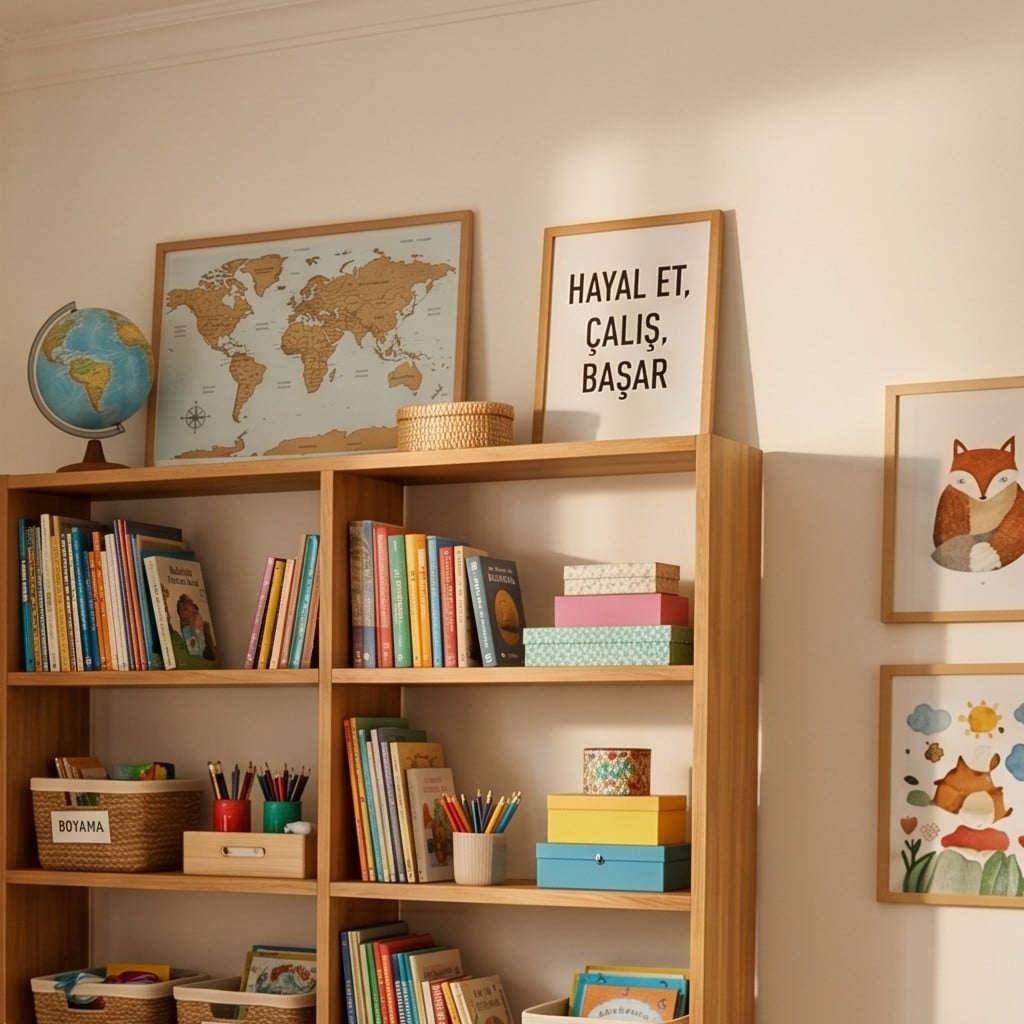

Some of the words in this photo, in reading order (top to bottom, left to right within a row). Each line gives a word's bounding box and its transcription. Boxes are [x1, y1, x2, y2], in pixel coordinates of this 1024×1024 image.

[569, 268, 646, 305] HAYAL
[657, 264, 690, 299] ET,
[586, 312, 667, 357] ÇALIŞ,
[582, 358, 668, 400] BAŞAR
[59, 820, 104, 833] BOYAMA
